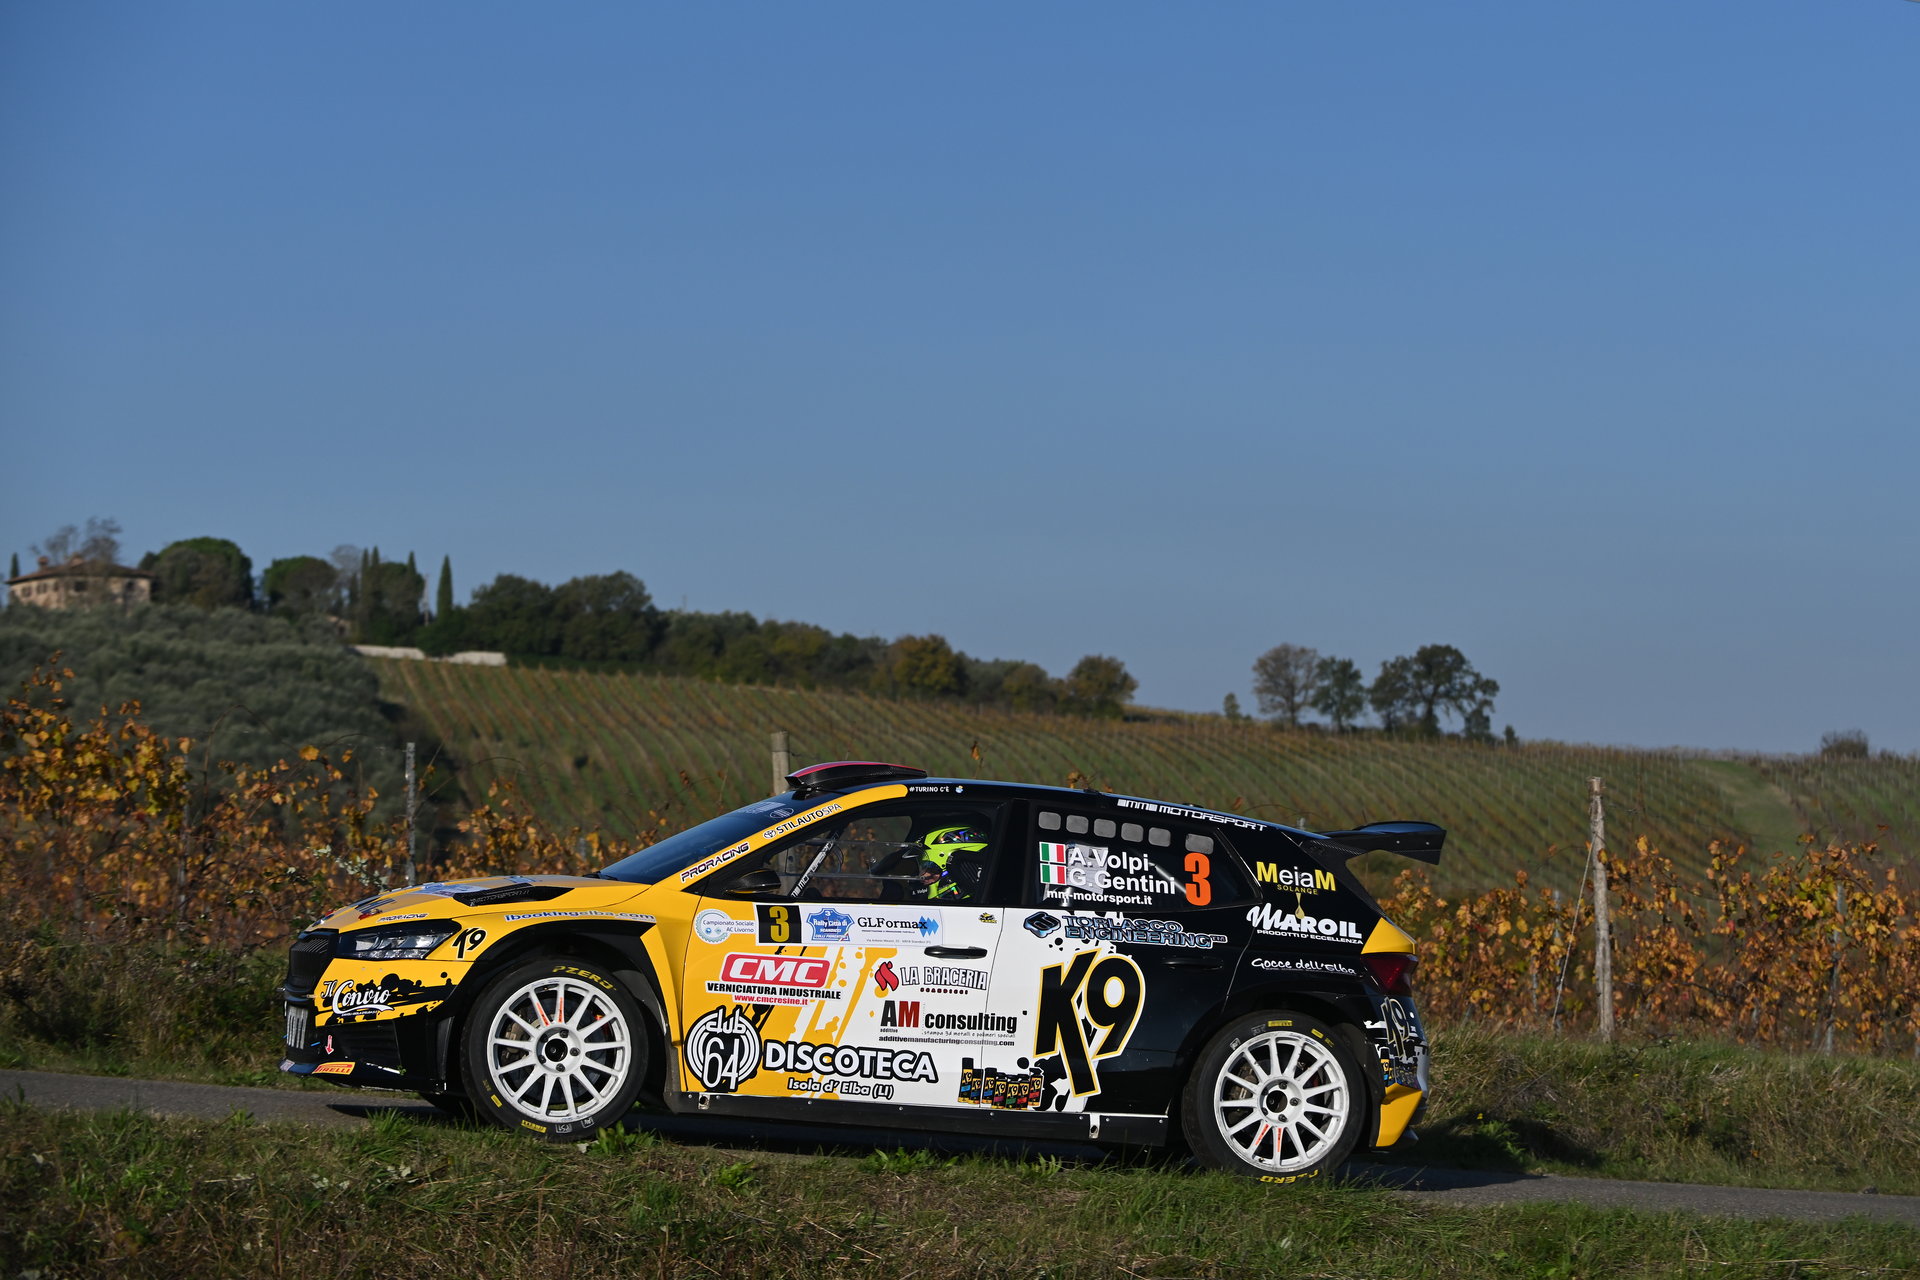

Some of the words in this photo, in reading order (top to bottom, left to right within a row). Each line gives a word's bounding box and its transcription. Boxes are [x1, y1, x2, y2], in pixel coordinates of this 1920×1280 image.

[1158, 805, 1268, 832] MOTORSPORT
[680, 842, 750, 882] PRORACING
[1183, 852, 1212, 907] 3
[1256, 861, 1337, 892] MeiaM
[1276, 883, 1319, 895] SOLANGE
[1046, 888, 1152, 905] mm-motorsport.it
[768, 905, 790, 943] 3
[857, 916, 928, 930] GLFormax
[1061, 915, 1183, 933] TORLASCO
[1246, 902, 1363, 939] MAROIL
[452, 928, 486, 959] K9
[1256, 929, 1300, 938] PRODOTTI
[1310, 934, 1364, 945] ECCELLENZA
[729, 957, 824, 984] CMC
[1250, 957, 1292, 969] Gocce
[707, 982, 777, 995] VERNICIATURA
[779, 988, 841, 999] INDUSTRIALE
[899, 966, 920, 986] LA
[923, 966, 989, 991] BRACERIA
[734, 994, 809, 1005] www.cmcresine.it
[705, 1007, 746, 1034] club
[880, 1000, 921, 1028] AM
[924, 1012, 1018, 1034] consulting
[1033, 948, 1145, 1098] K9
[878, 1035, 1015, 1046] additivemanufacturingconsulting.com
[702, 1036, 740, 1090] 64
[764, 1042, 937, 1082] DISCOTECA
[788, 1078, 821, 1092] Isola
[841, 1081, 870, 1095] Elba
